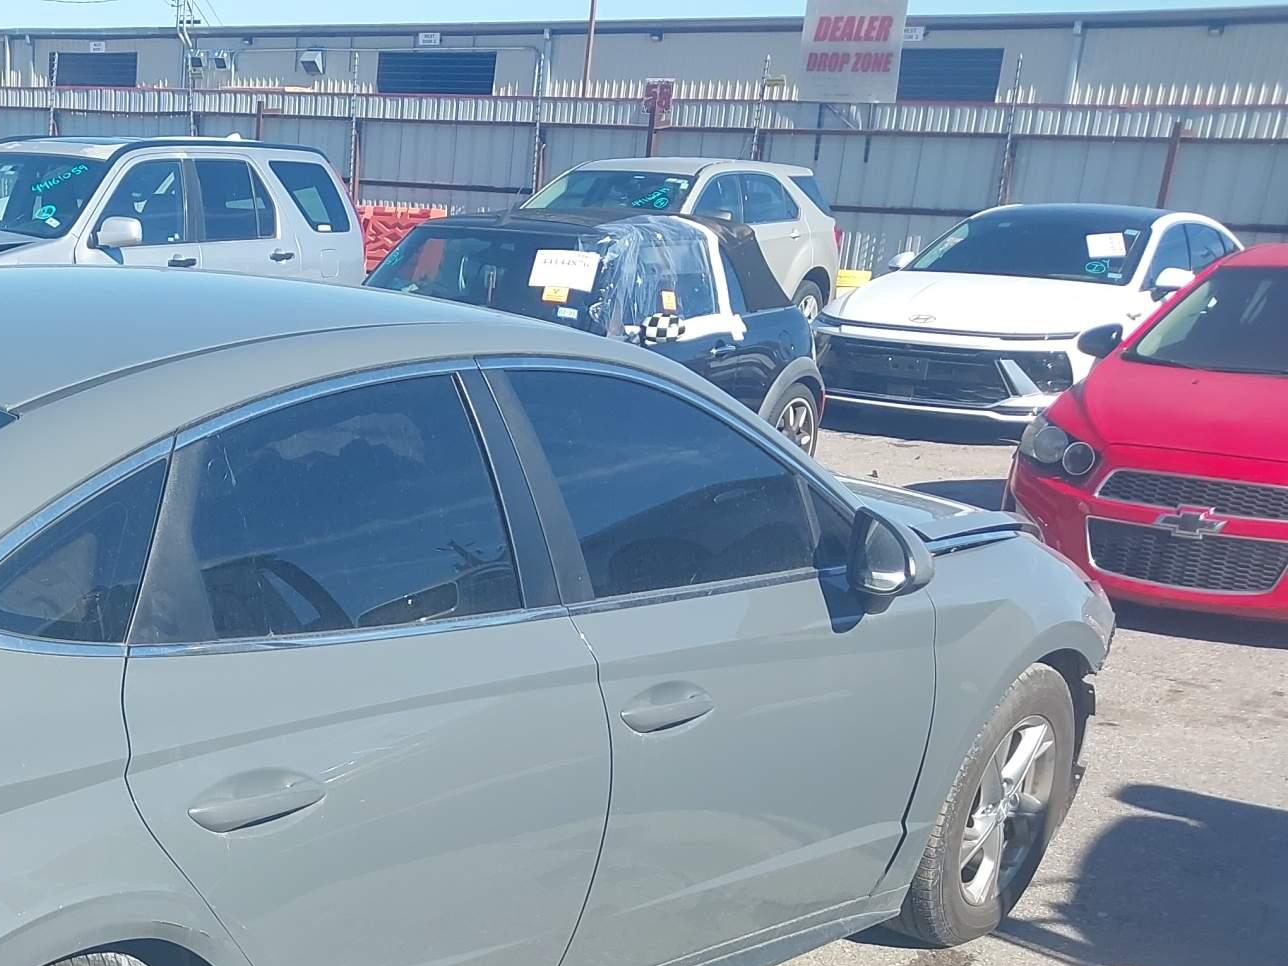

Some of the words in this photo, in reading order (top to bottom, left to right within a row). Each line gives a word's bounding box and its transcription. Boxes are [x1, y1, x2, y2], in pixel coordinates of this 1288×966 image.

[813, 15, 893, 42] DEALER
[806, 52, 850, 72] DROP
[850, 52, 893, 72] ZONE
